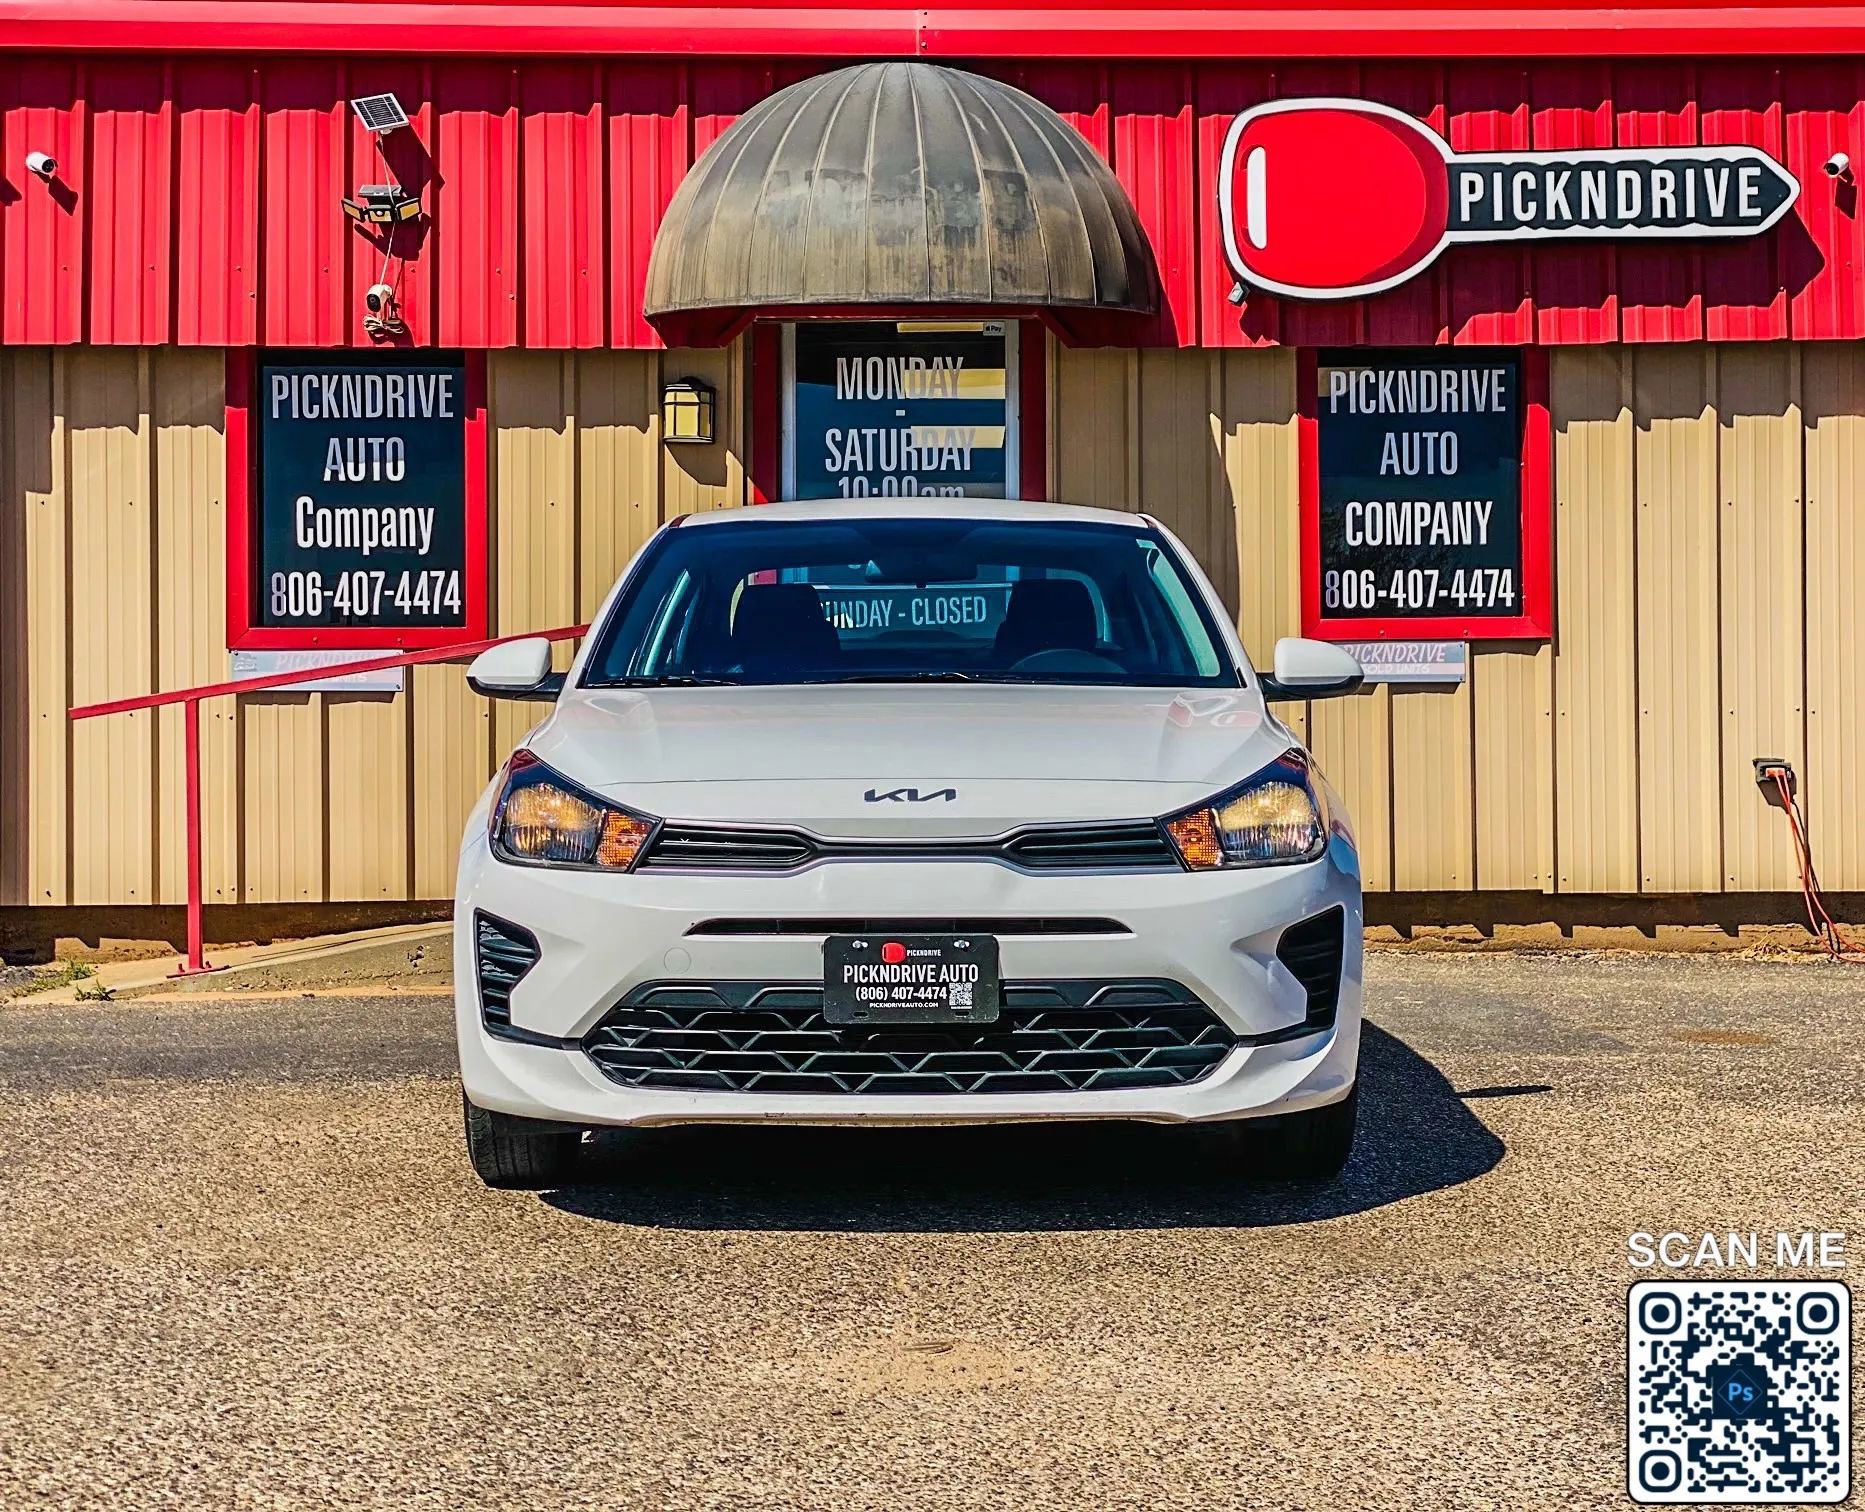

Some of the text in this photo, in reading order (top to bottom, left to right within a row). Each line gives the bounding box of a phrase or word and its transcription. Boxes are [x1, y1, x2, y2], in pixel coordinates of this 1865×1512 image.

[1459, 167, 1762, 222] PICKNDRIVE
[271, 374, 454, 419] PICKNDRIVE
[836, 356, 964, 400] MONDAY
[1329, 368, 1506, 414] PICKNDRIVE
[323, 437, 406, 482] AUTO
[825, 428, 977, 473] SATURDAY
[1379, 431, 1459, 476] AUTO
[296, 495, 435, 556] Company
[1345, 501, 1493, 546] COMPANY
[271, 570, 461, 617] 806-407-4474
[1325, 568, 1515, 609] 806-407-4474
[821, 599, 893, 629] UNDAY
[911, 596, 987, 626] CLOSED
[843, 964, 979, 984] PICKNDRIVE AUTO
[906, 949, 942, 957] PICKNDRIVE
[855, 986, 948, 1001] (806) 407-4474
